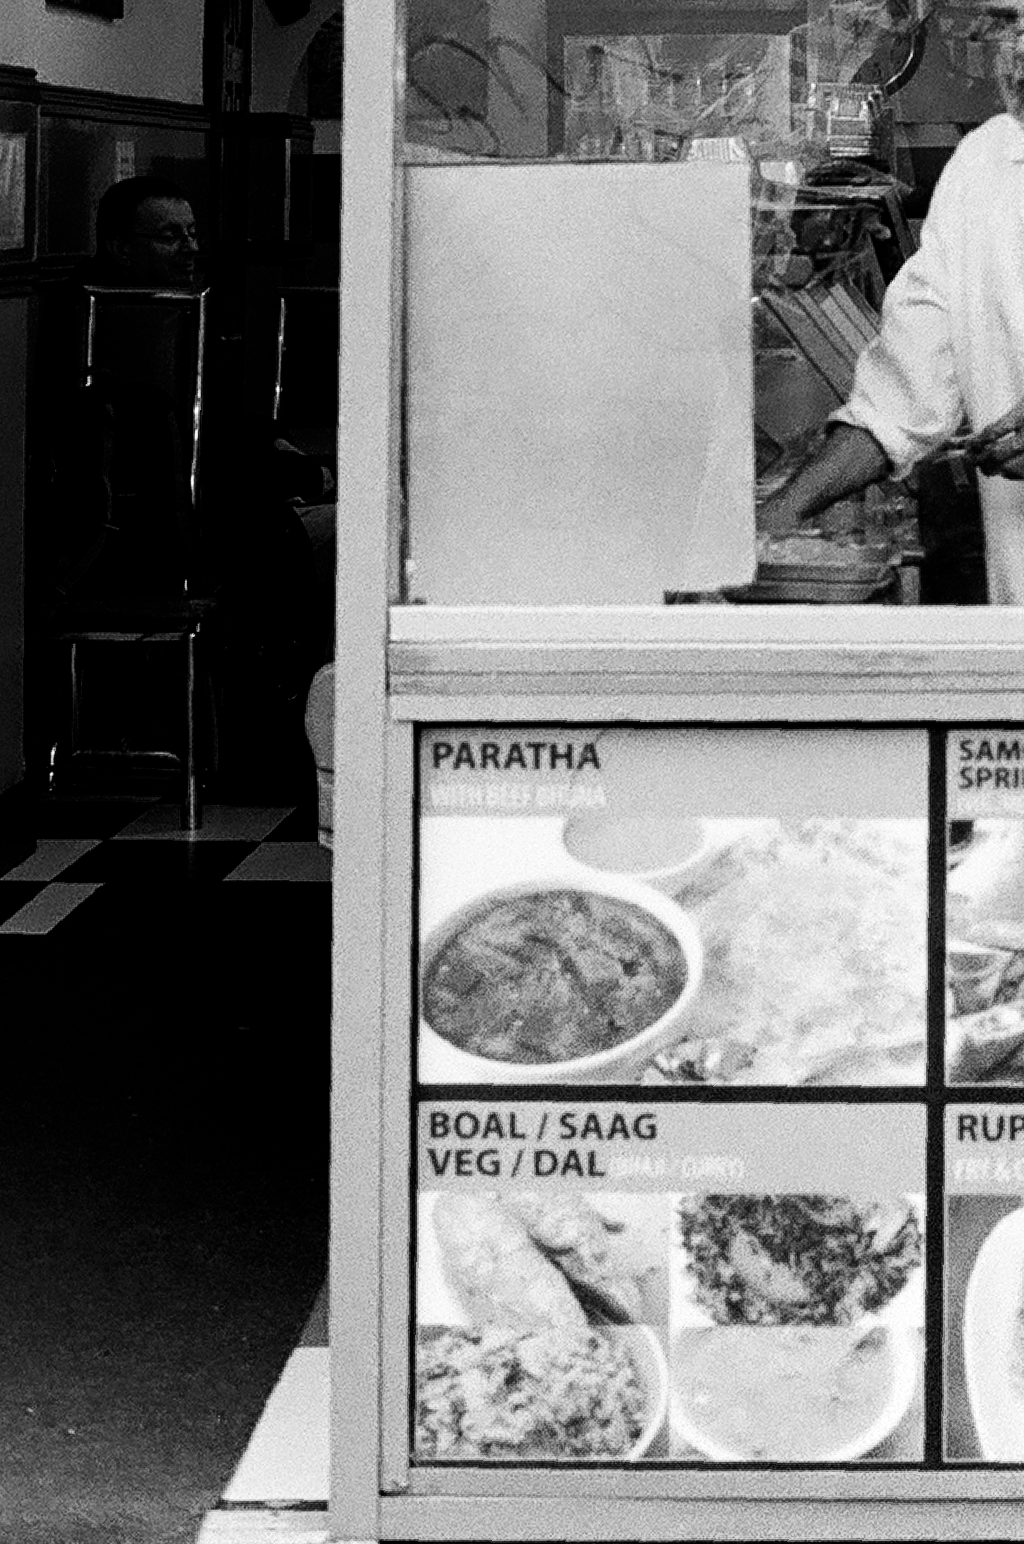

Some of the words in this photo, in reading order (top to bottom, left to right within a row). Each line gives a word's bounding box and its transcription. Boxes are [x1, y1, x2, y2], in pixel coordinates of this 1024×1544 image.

[433, 741, 601, 770] PARATHA
[430, 1112, 525, 1140] BOAL
[560, 1111, 657, 1140] SAAG
[427, 1148, 501, 1177] VEG
[534, 1149, 606, 1177] DAL
